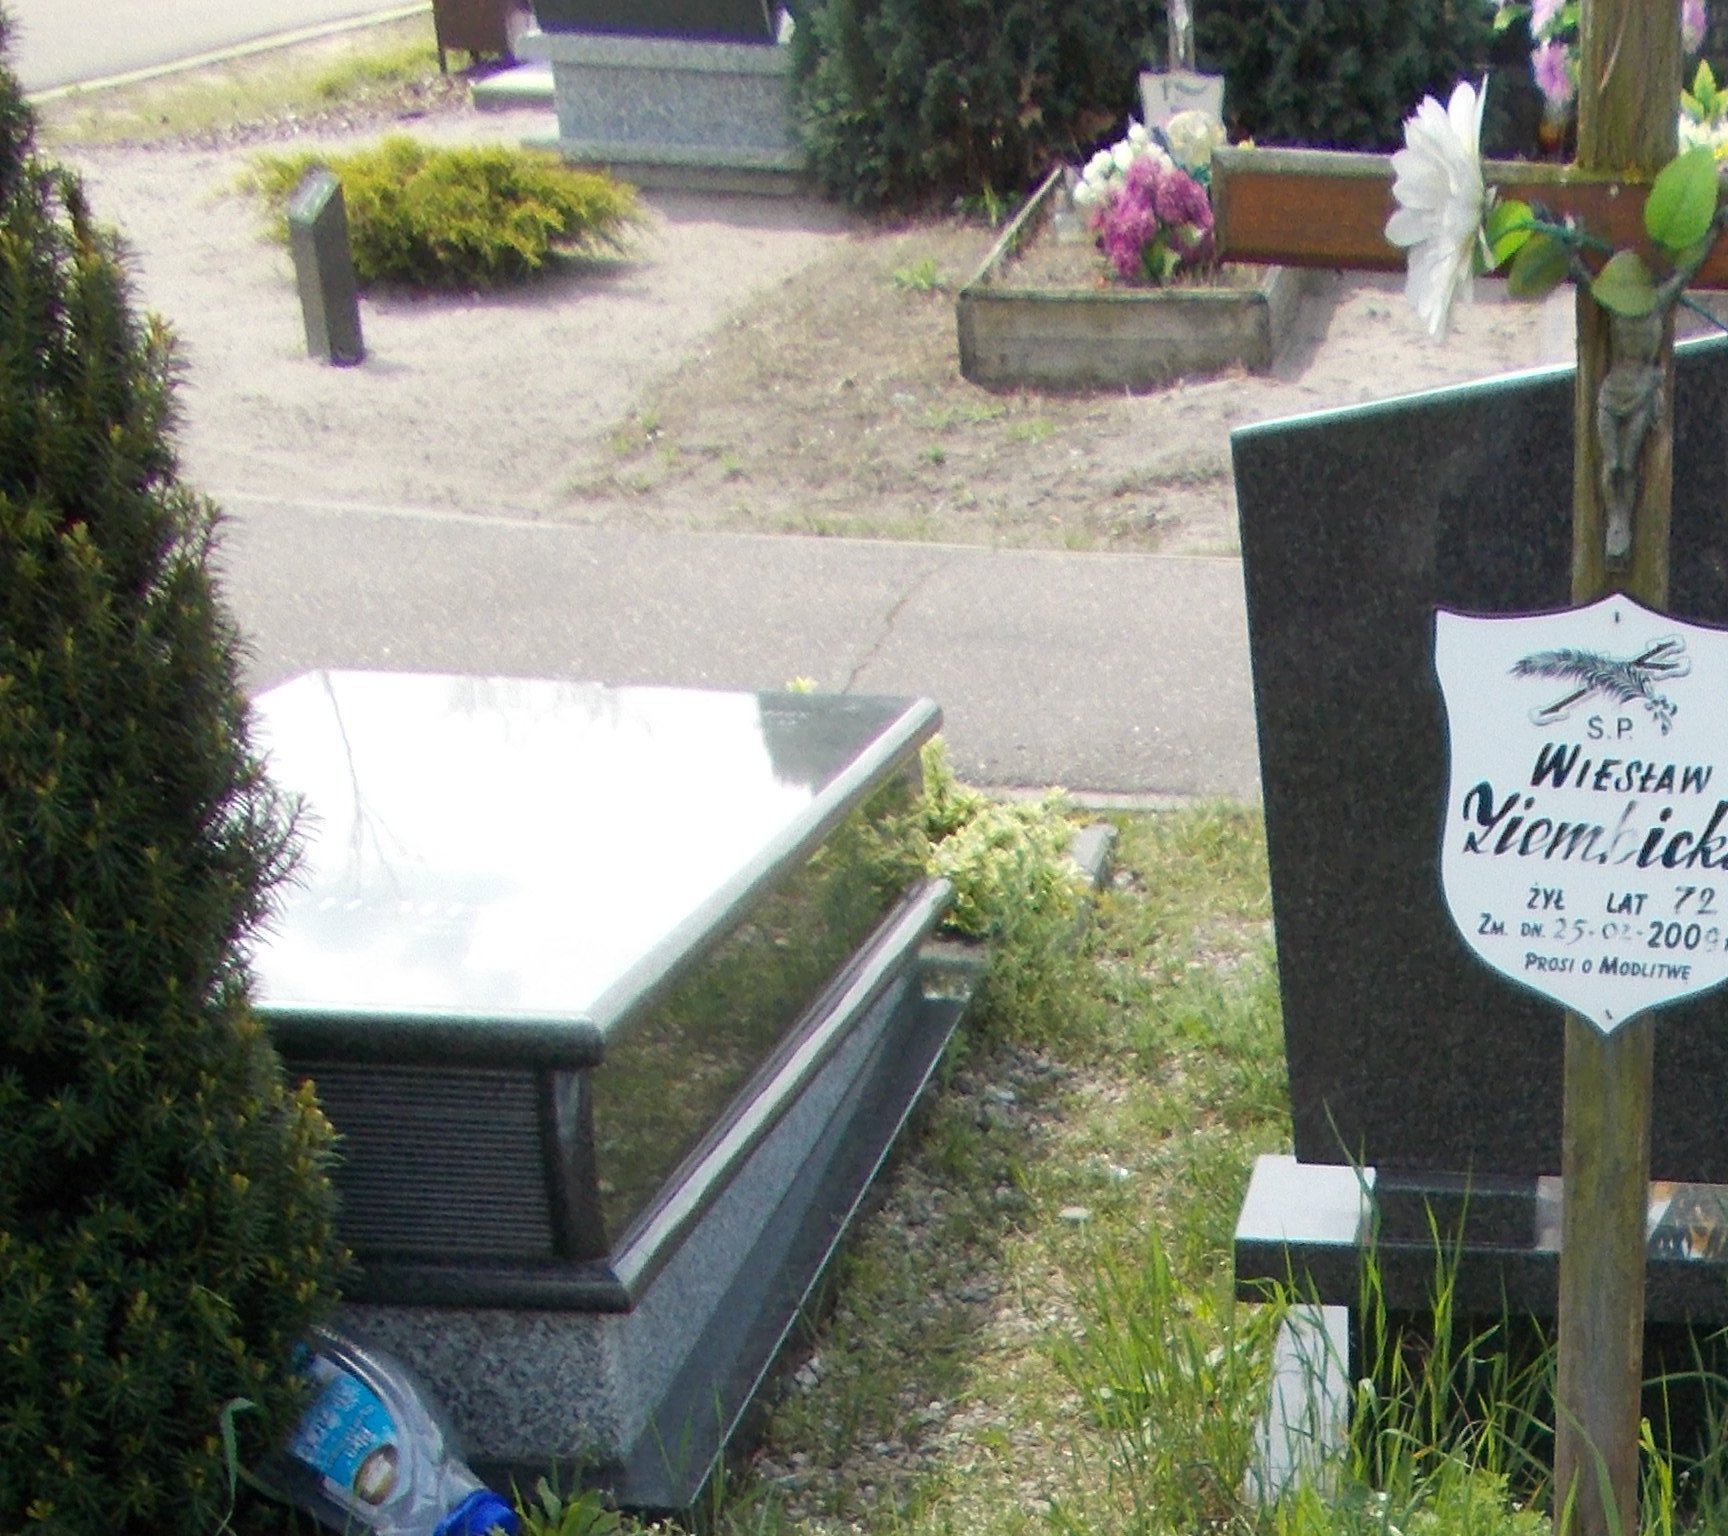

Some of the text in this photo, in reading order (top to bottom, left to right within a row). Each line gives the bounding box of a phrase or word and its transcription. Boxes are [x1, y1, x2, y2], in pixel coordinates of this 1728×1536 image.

[1529, 742, 1713, 796] WIESŁAW
[1526, 882, 1720, 916] ŻYŁ LAT 72
